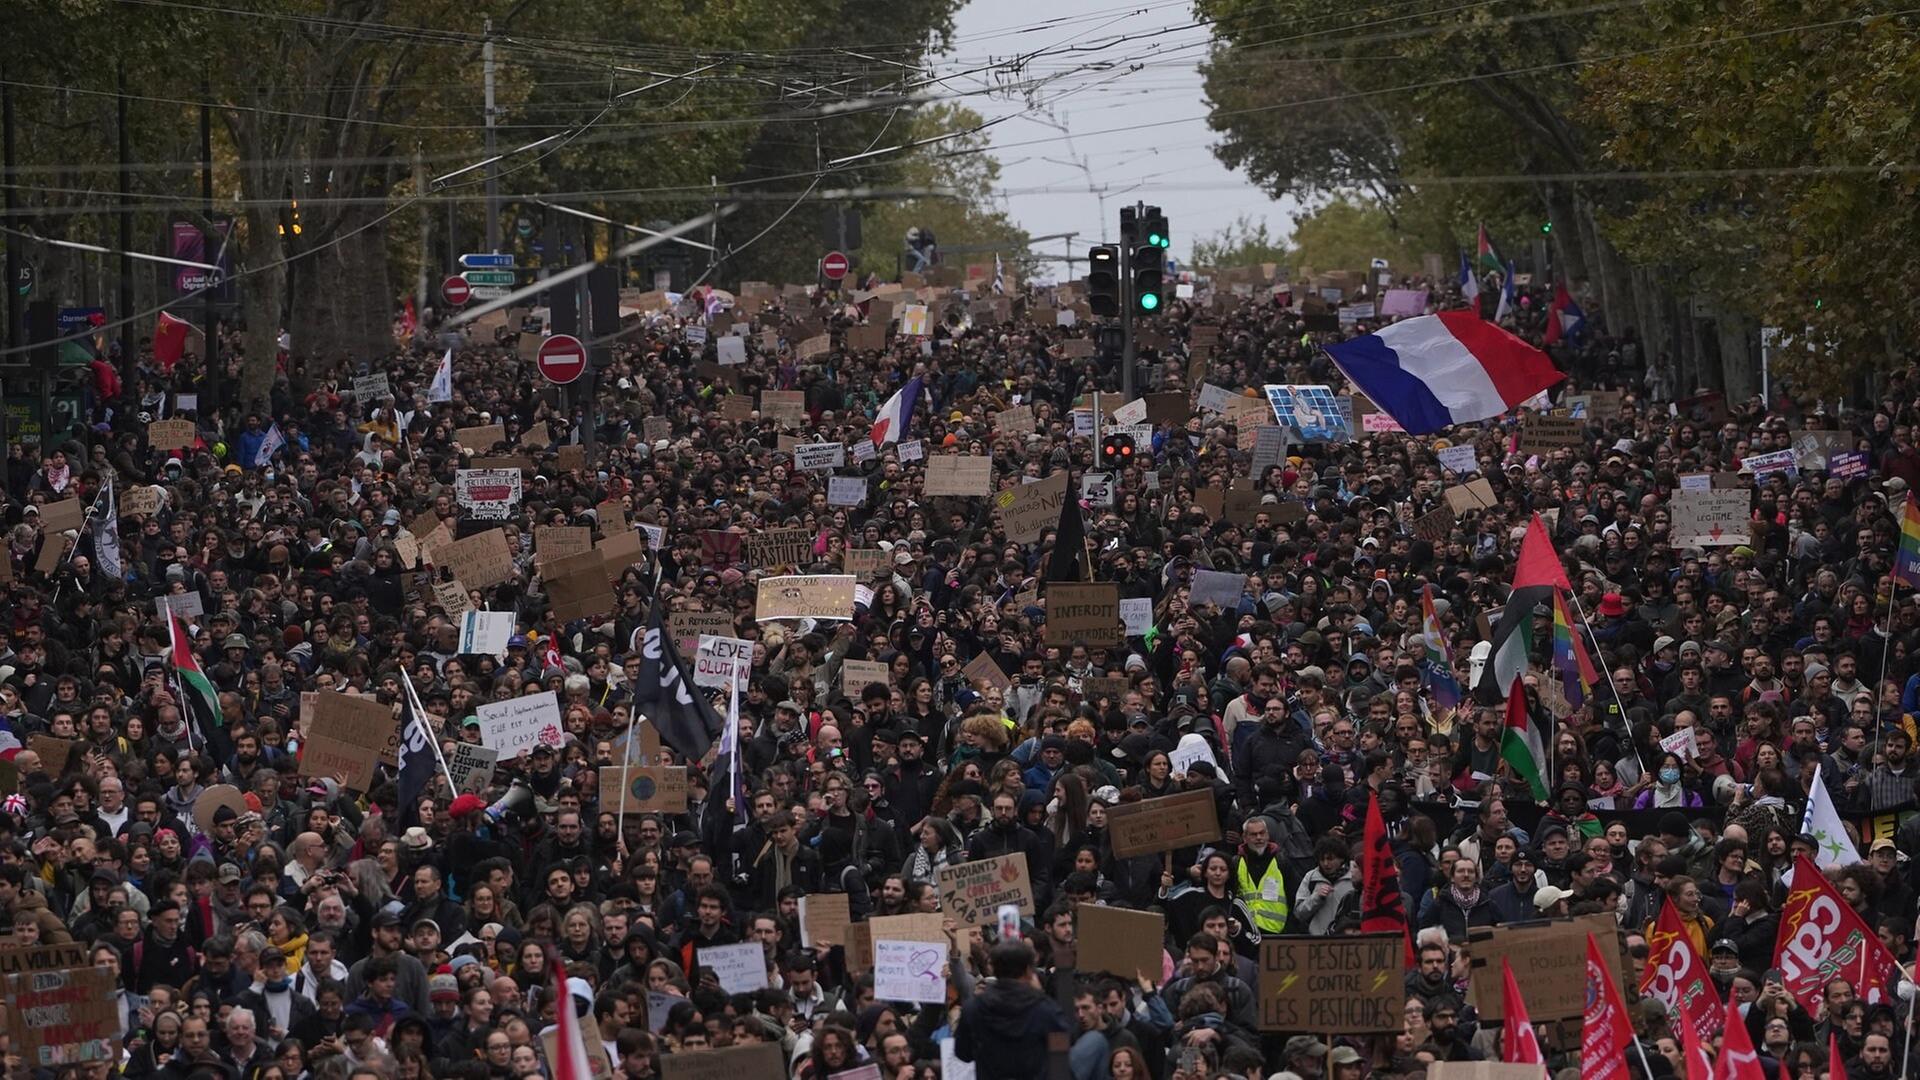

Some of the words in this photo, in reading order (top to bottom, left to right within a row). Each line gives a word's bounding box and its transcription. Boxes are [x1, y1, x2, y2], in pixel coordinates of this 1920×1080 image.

[750, 544, 811, 569] BASTILLE?
[674, 617, 684, 625] LA
[1054, 605, 1115, 618] INTERDIT
[697, 659, 750, 680] OLUTIN
[457, 744, 473, 756] LES
[451, 764, 471, 776] C'EST
[453, 755, 490, 770] CASSEURS
[941, 860, 998, 881] ETUDIANTS
[966, 881, 1002, 898] CONTRE
[943, 890, 977, 924] ACAB
[2, 956, 22, 972] LA
[27, 951, 64, 969] VOILA
[68, 949, 83, 965] TA
[1266, 944, 1296, 971] LES
[1307, 942, 1362, 970] PESTES
[1308, 974, 1363, 993] CONTRE
[1264, 998, 1299, 1026] LES
[1309, 994, 1399, 1030] PESTICIDES
